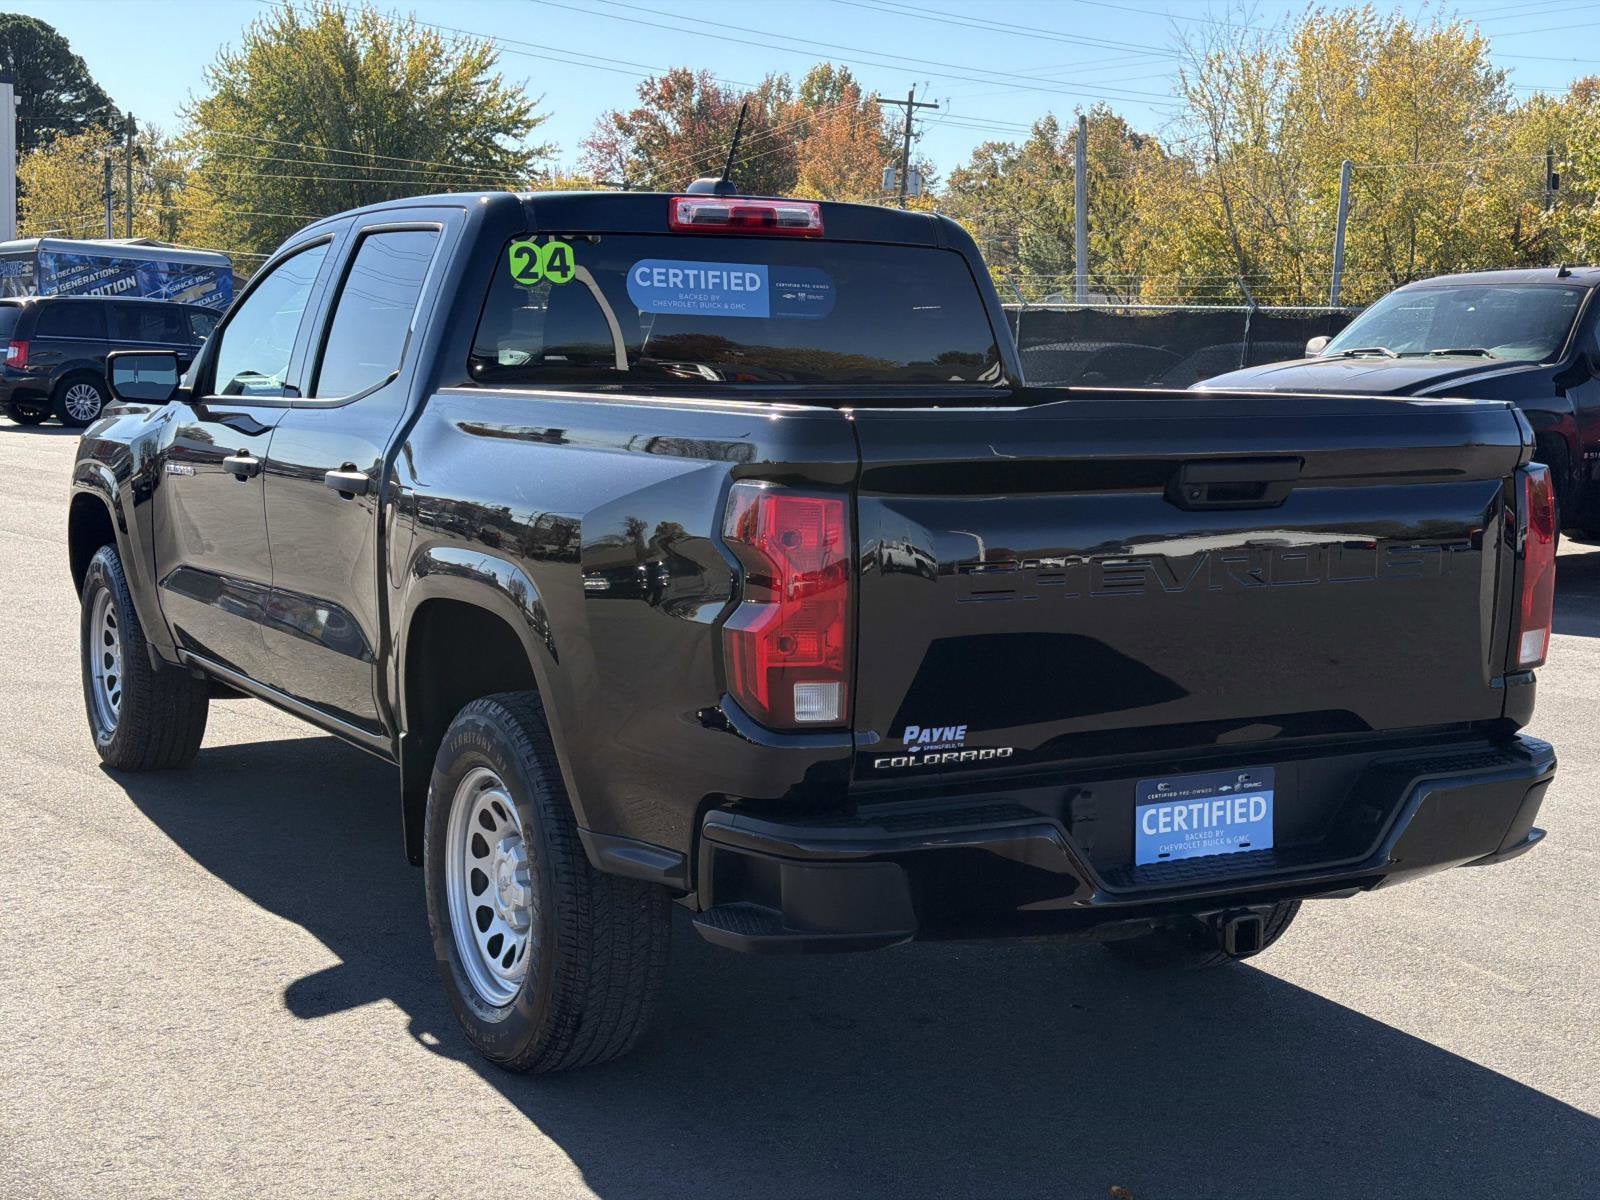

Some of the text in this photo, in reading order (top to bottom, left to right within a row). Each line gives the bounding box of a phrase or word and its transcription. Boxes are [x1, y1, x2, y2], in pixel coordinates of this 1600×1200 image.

[514, 246, 571, 279] 24
[59, 265, 120, 291] GENERATIONS
[83, 275, 137, 297] DITION
[169, 278, 194, 293] SINCE
[634, 266, 761, 292] CERTIFIED
[678, 293, 709, 301] BACKED
[699, 301, 721, 309] BUICK
[903, 724, 968, 745] PAYNE
[874, 747, 1013, 769] COLORADO
[1142, 796, 1267, 835] CERTIFIED
[1184, 829, 1225, 842] BACKED BY
[1203, 837, 1225, 849] BUICK
[1233, 833, 1250, 844] GMC
